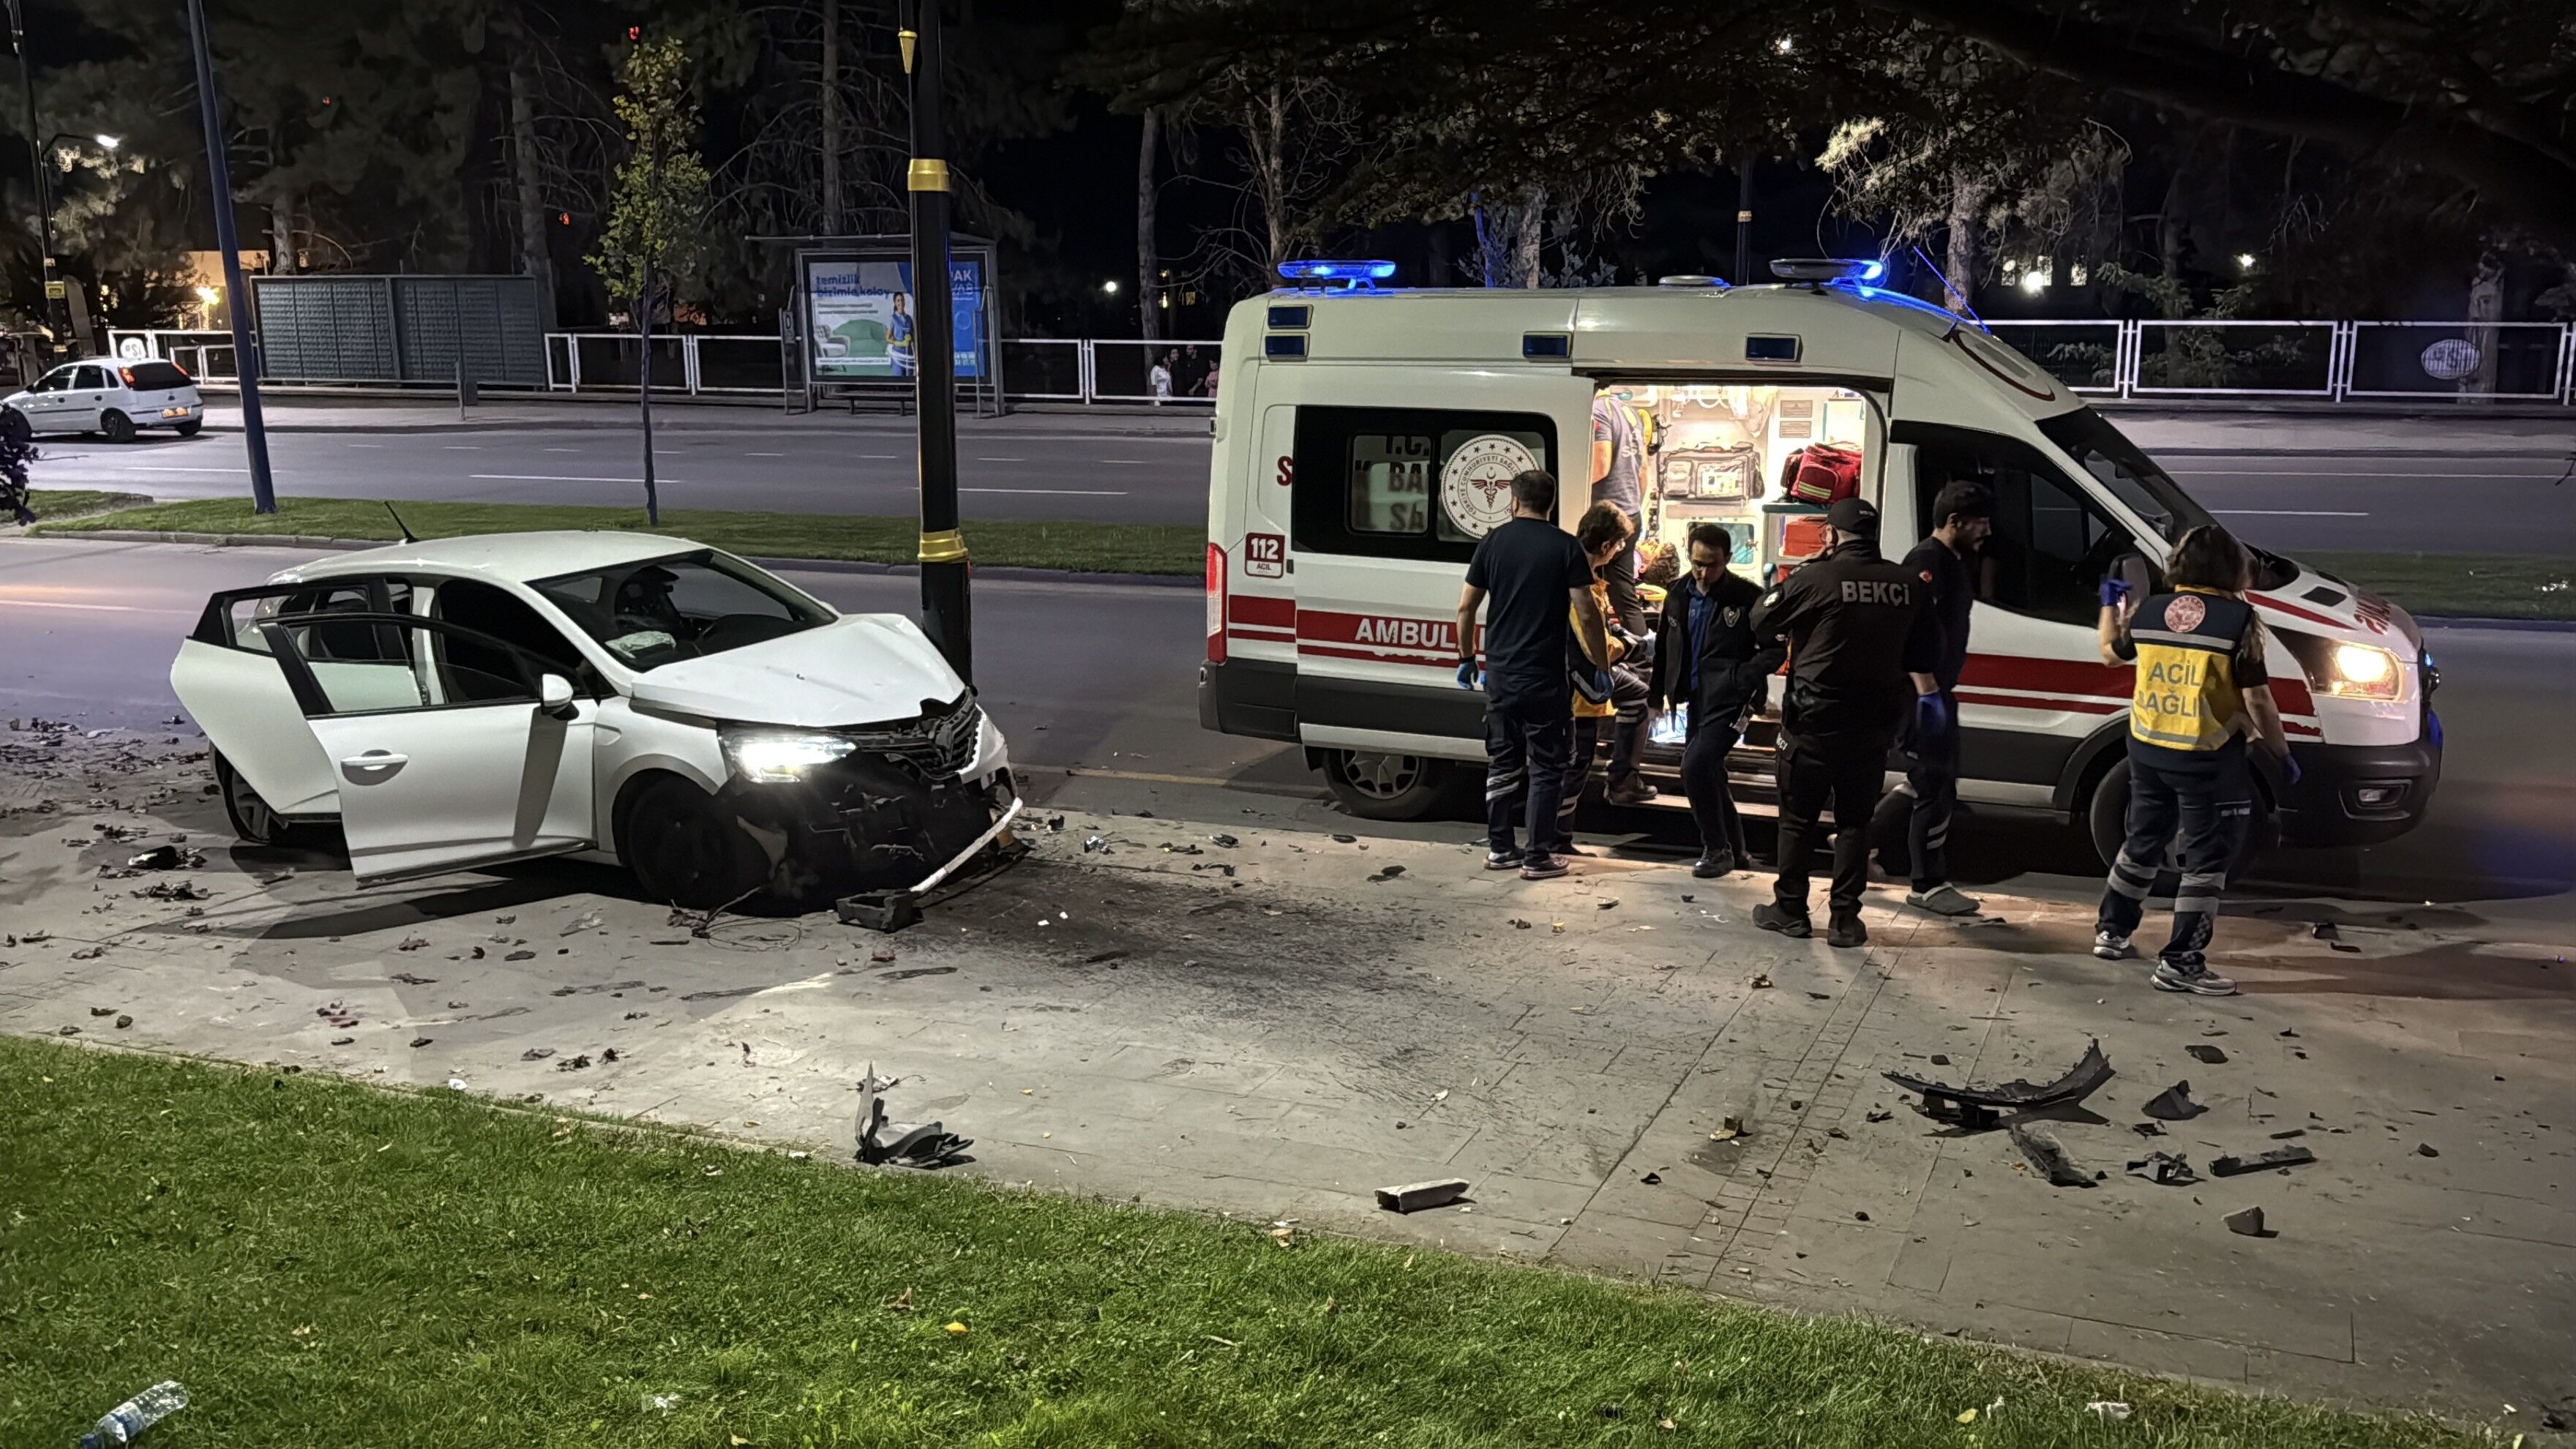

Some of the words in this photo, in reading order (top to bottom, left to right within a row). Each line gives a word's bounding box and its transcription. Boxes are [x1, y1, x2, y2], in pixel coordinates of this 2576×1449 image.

[1251, 537, 1279, 561] 112
[1841, 580, 1911, 607] BEKÇİ
[1355, 618, 1486, 650] AMBUL
[2147, 659, 2201, 687] ACİL
